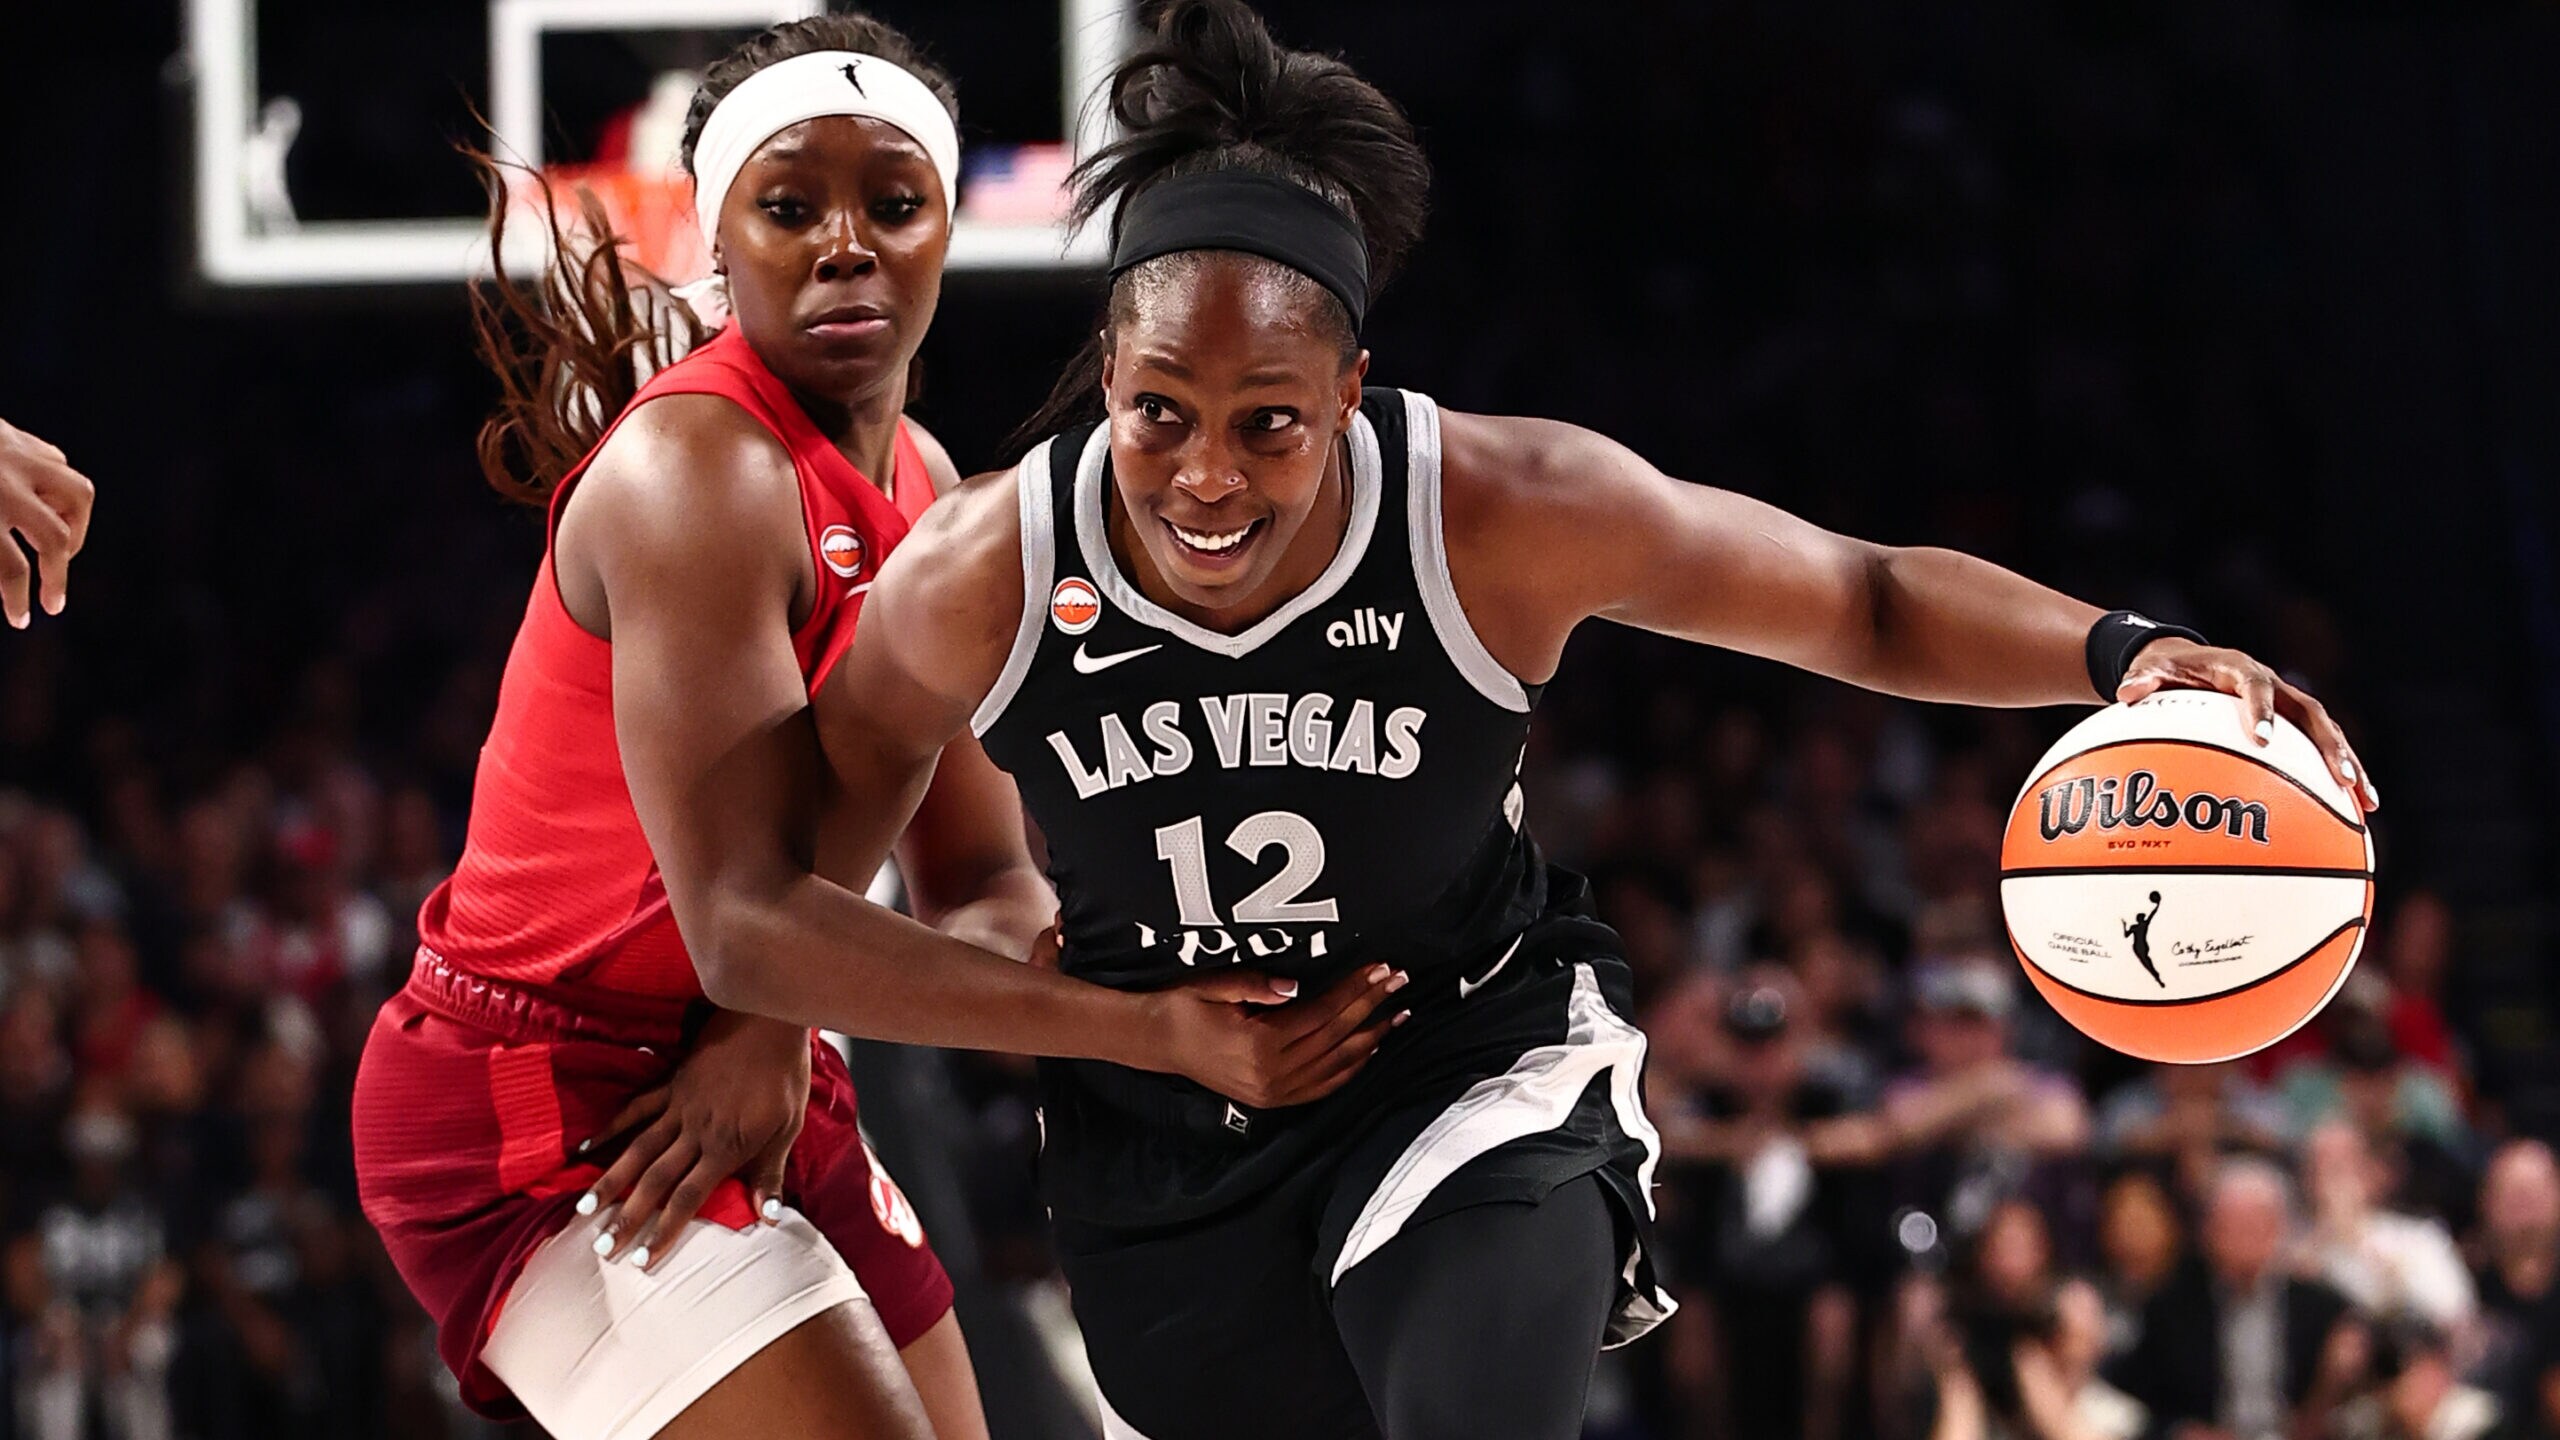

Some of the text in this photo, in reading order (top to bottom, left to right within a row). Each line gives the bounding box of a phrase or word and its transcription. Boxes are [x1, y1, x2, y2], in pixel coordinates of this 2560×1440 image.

[1326, 607, 1405, 651] ally
[1045, 692, 1427, 800] LAS VEGAS
[2039, 770, 2270, 844] Wilson
[1154, 810, 1340, 927] 12
[2108, 840, 2171, 849] EVO NXT
